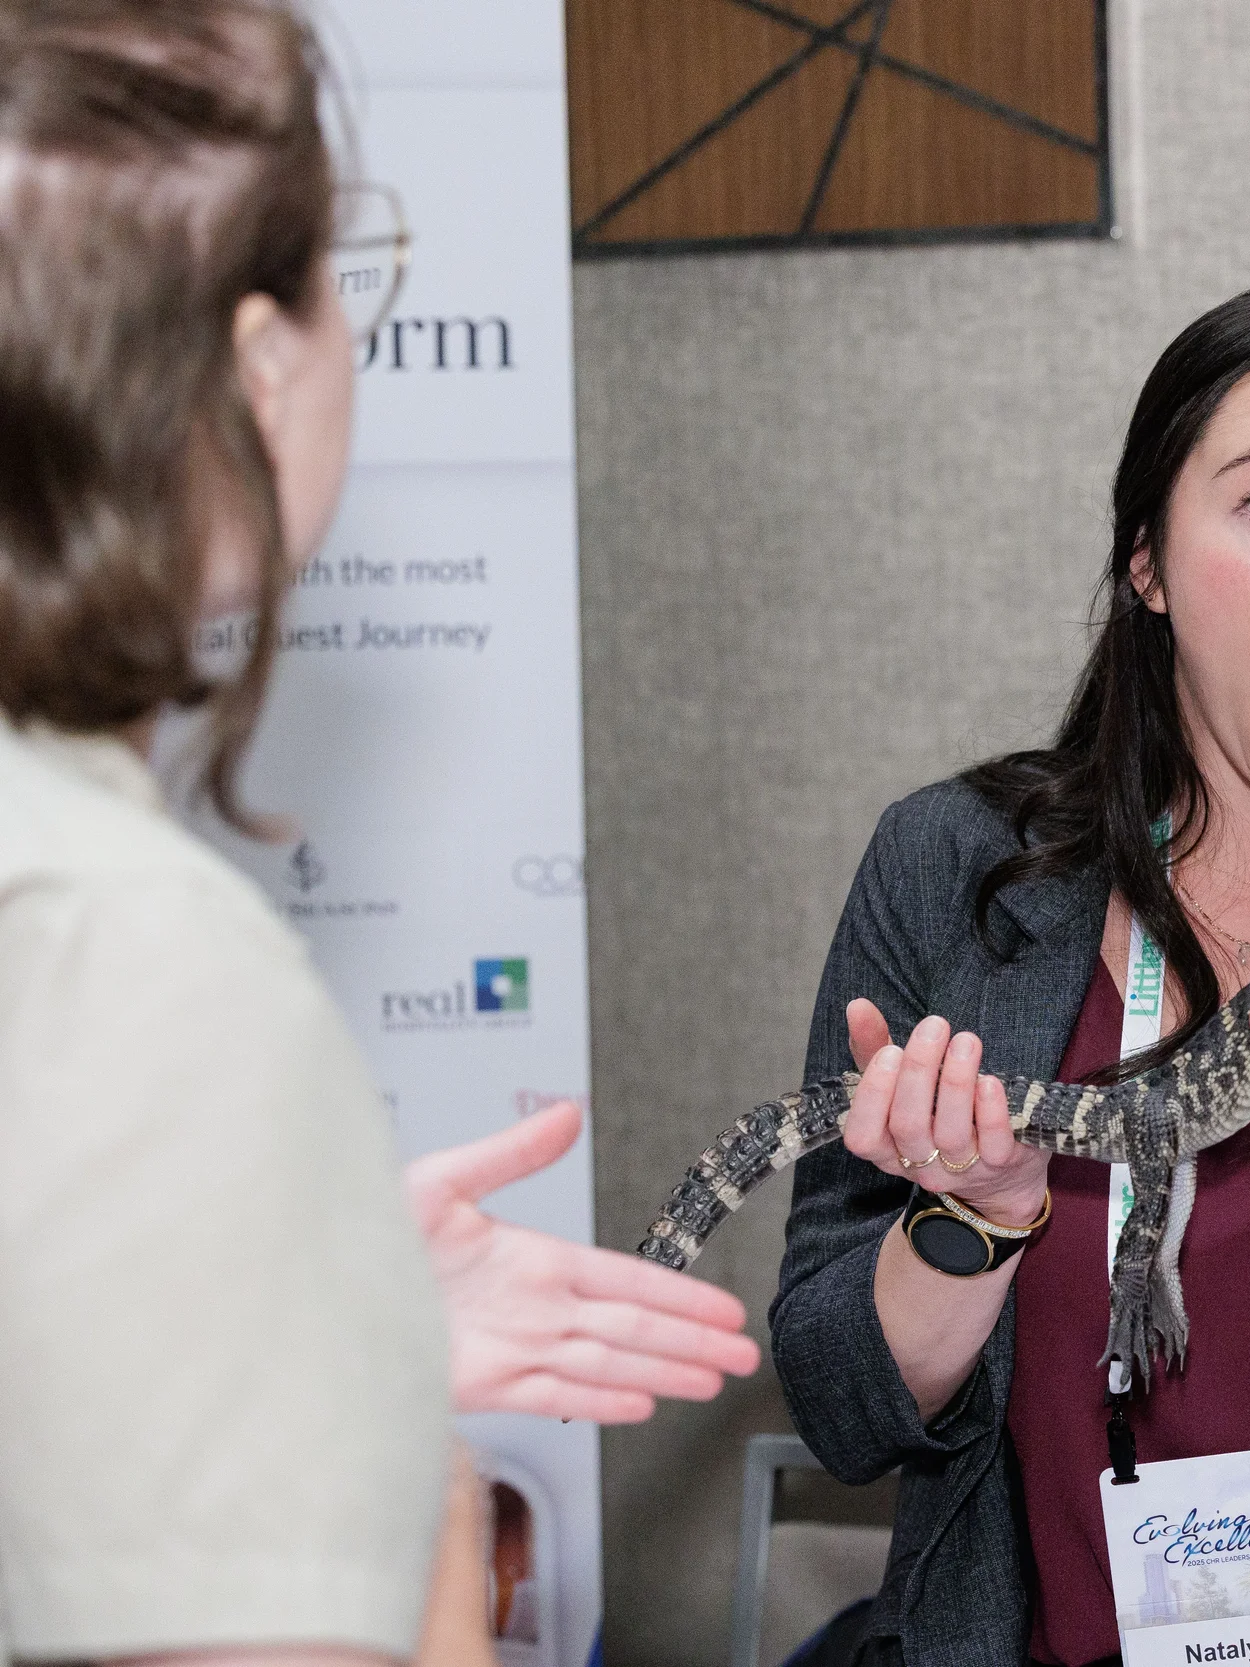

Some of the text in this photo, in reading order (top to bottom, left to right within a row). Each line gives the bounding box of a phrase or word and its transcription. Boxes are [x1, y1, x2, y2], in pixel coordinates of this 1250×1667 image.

[342, 553, 397, 588] the
[404, 555, 488, 586] most
[357, 615, 490, 655] Journey
[381, 977, 467, 1020] real
[1187, 1559, 1206, 1567] 2025
[1206, 1557, 1220, 1566] CHR
